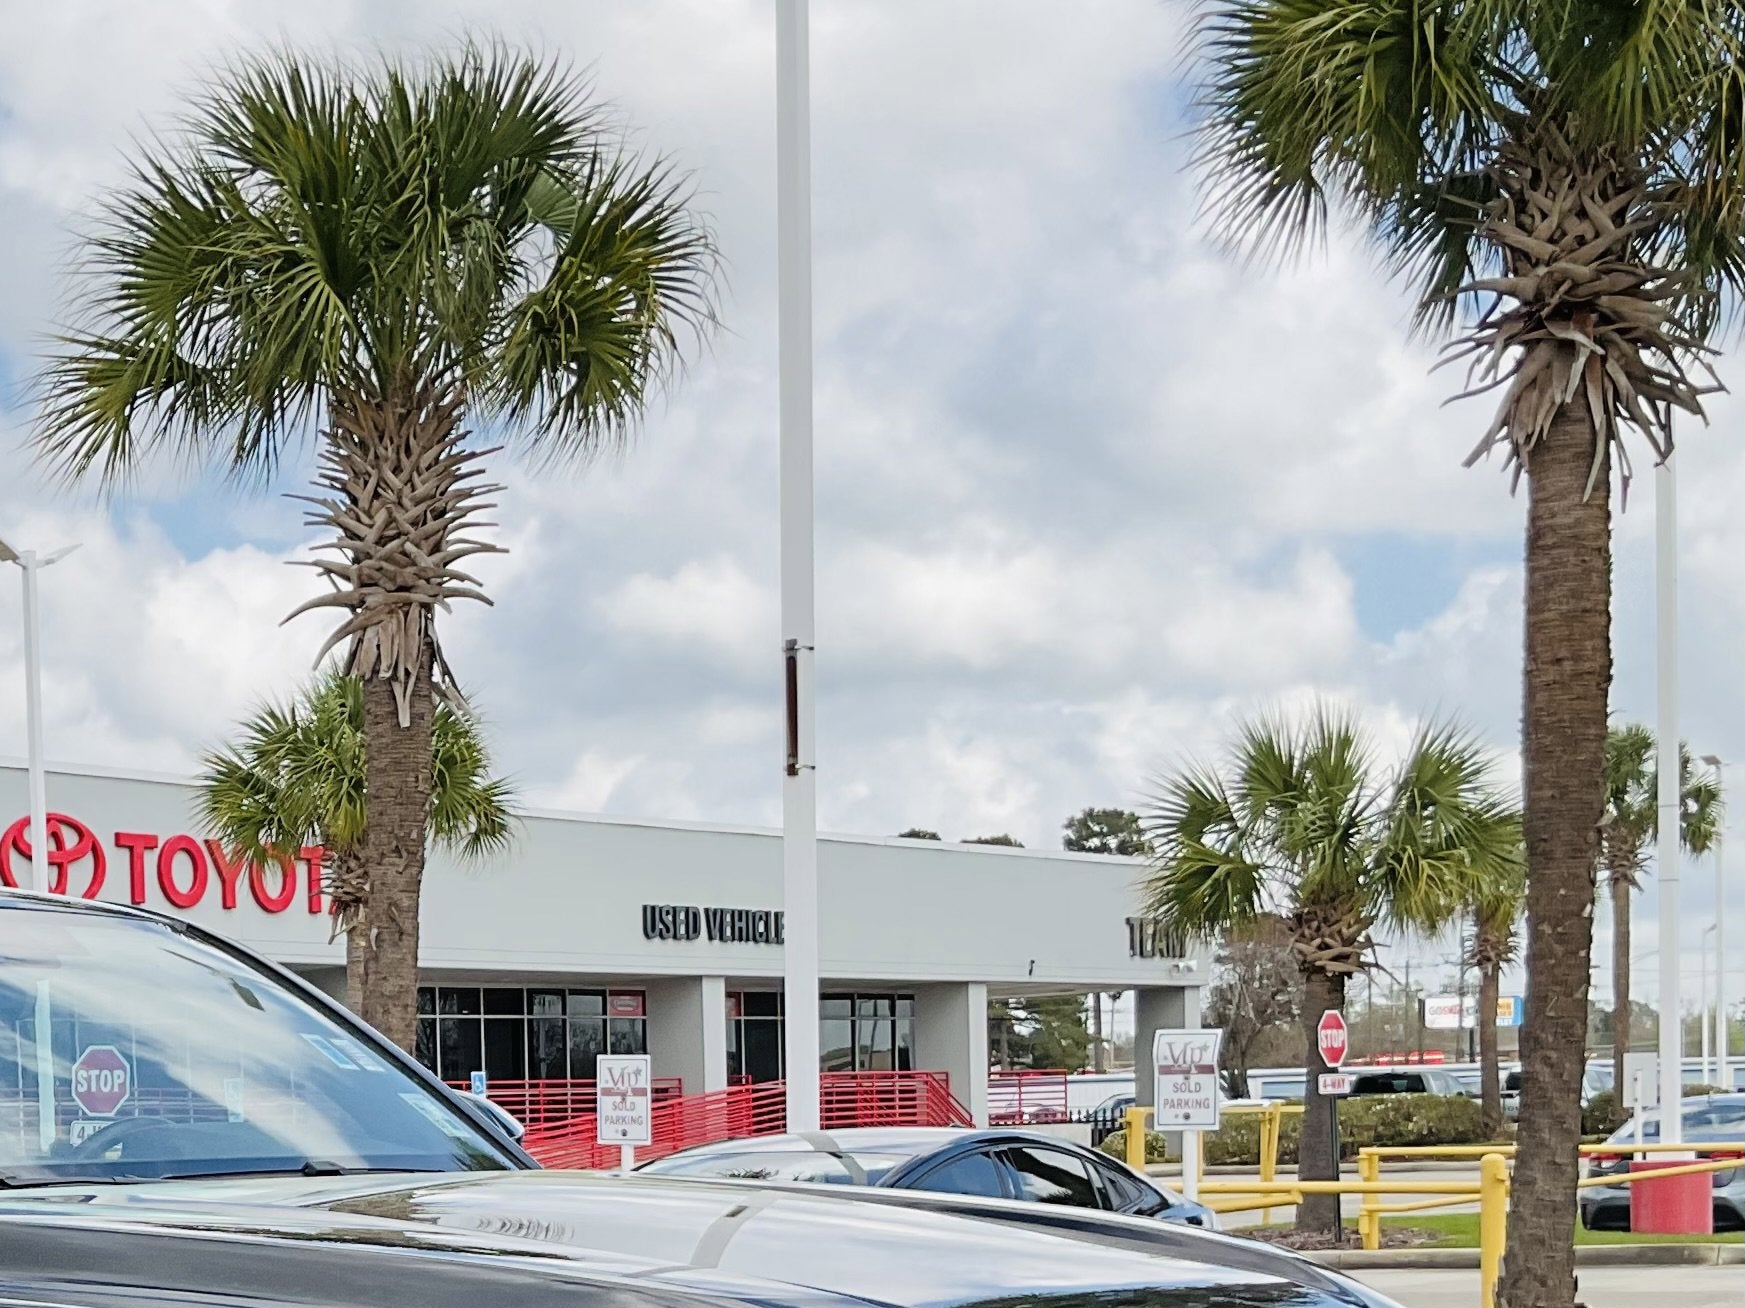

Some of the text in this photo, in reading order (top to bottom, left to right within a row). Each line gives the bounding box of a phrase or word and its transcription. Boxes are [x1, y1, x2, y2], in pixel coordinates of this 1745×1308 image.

[115, 832, 336, 914] TOYOT
[642, 904, 701, 941] USED
[1321, 1029, 1345, 1048] STOP
[77, 1069, 125, 1093] STOP
[1322, 1078, 1346, 1089] 4-WAY
[1172, 1082, 1201, 1093] SOLD
[612, 1101, 636, 1111] SOLD
[1163, 1098, 1210, 1109] PARKING
[604, 1115, 643, 1125] PARKING
